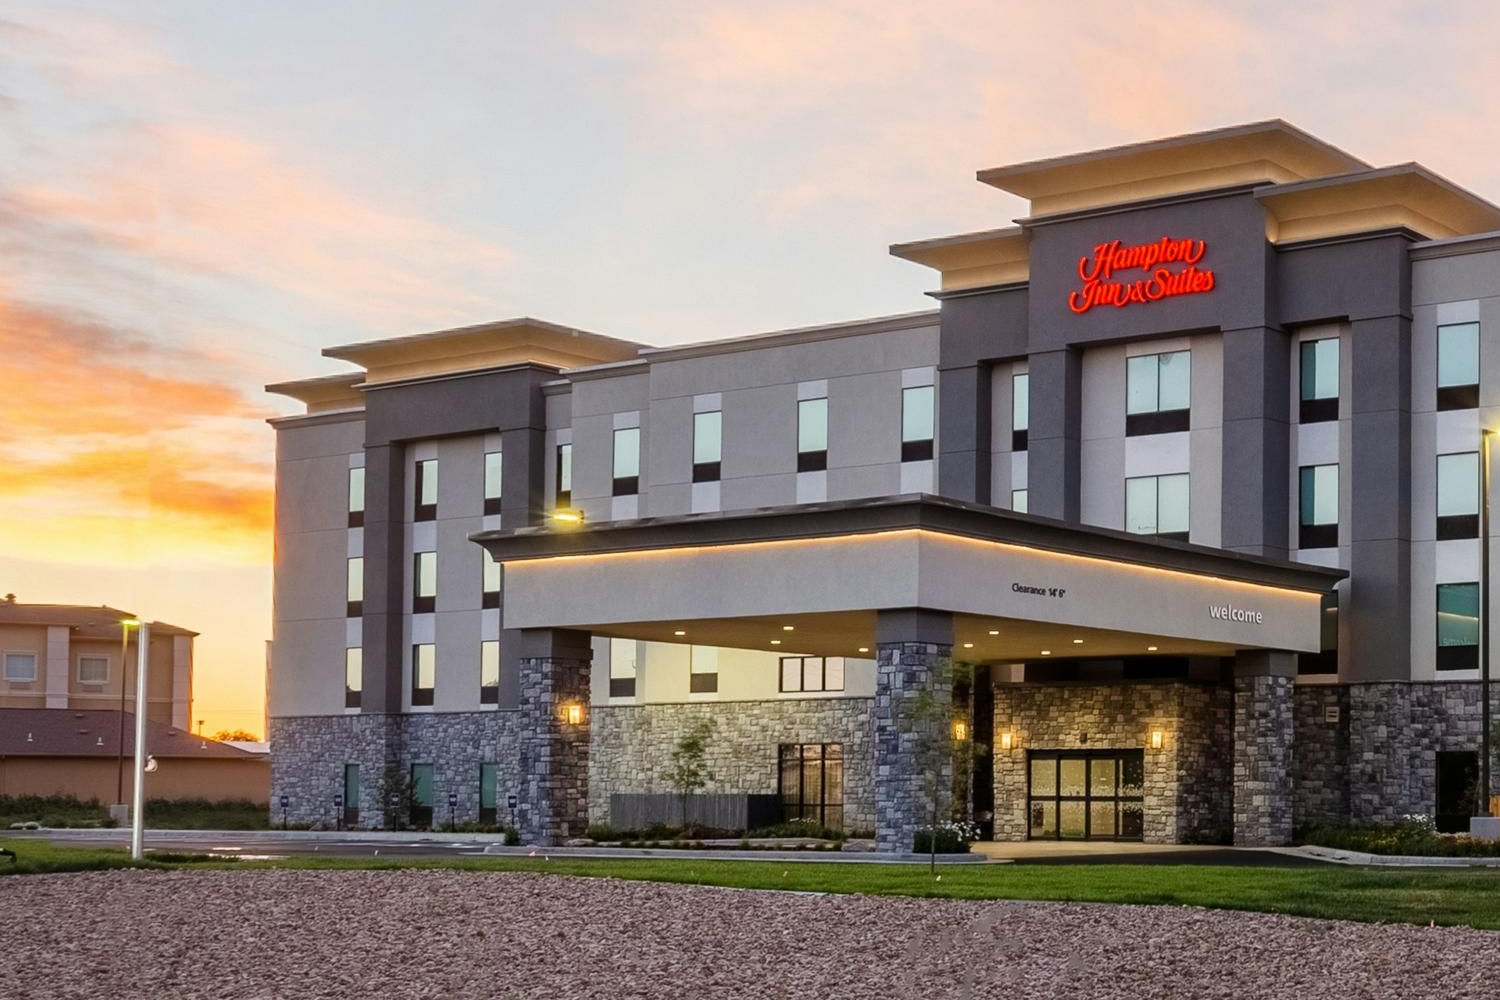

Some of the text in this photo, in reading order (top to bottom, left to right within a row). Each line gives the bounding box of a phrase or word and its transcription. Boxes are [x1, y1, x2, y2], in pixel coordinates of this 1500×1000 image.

[1079, 236, 1206, 281] Hampton
[1069, 267, 1215, 313] Inn & Suites
[1011, 582, 1046, 596] Clearance
[1208, 604, 1263, 624] welcome
